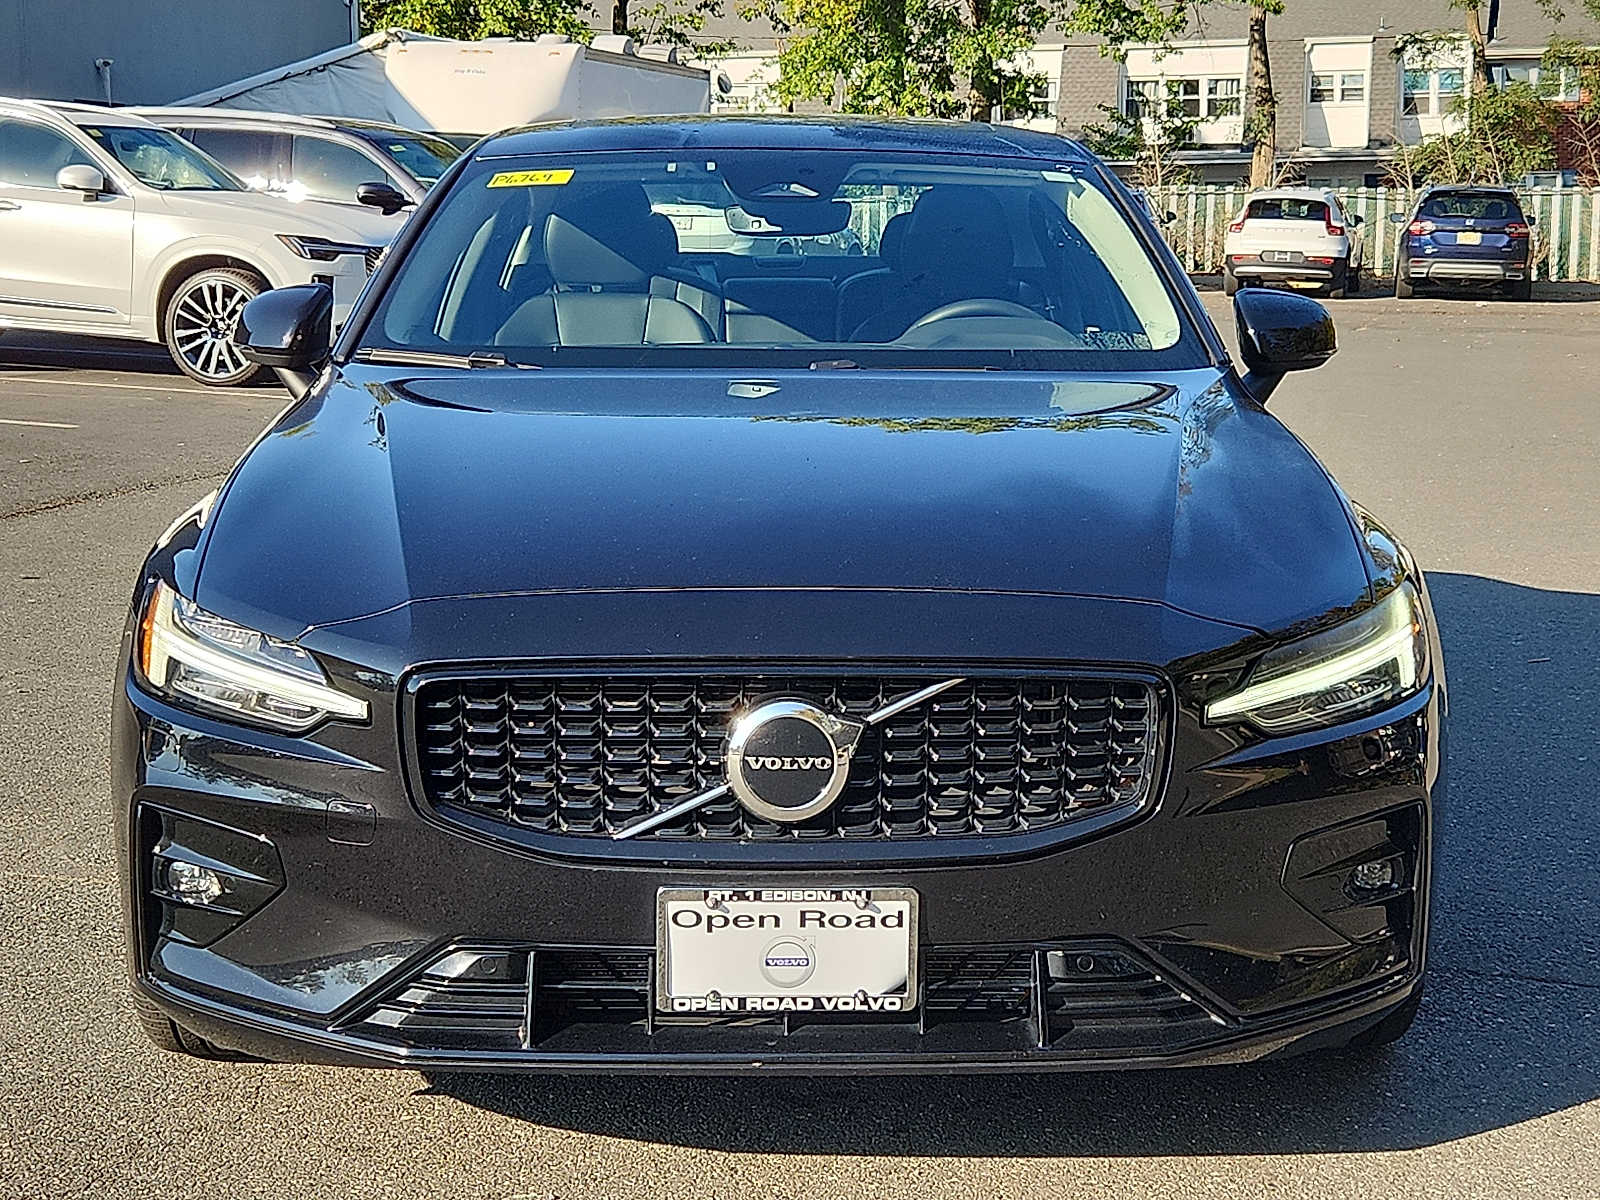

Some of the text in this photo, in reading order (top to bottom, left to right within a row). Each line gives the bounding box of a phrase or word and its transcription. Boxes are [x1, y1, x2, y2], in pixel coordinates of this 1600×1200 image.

[744, 757, 832, 770] VOLVO
[745, 890, 755, 901] 1
[671, 909, 904, 933] Open Road
[767, 958, 808, 967] VOLVO
[673, 998, 902, 1011] OPEN ROAD VOLVO
